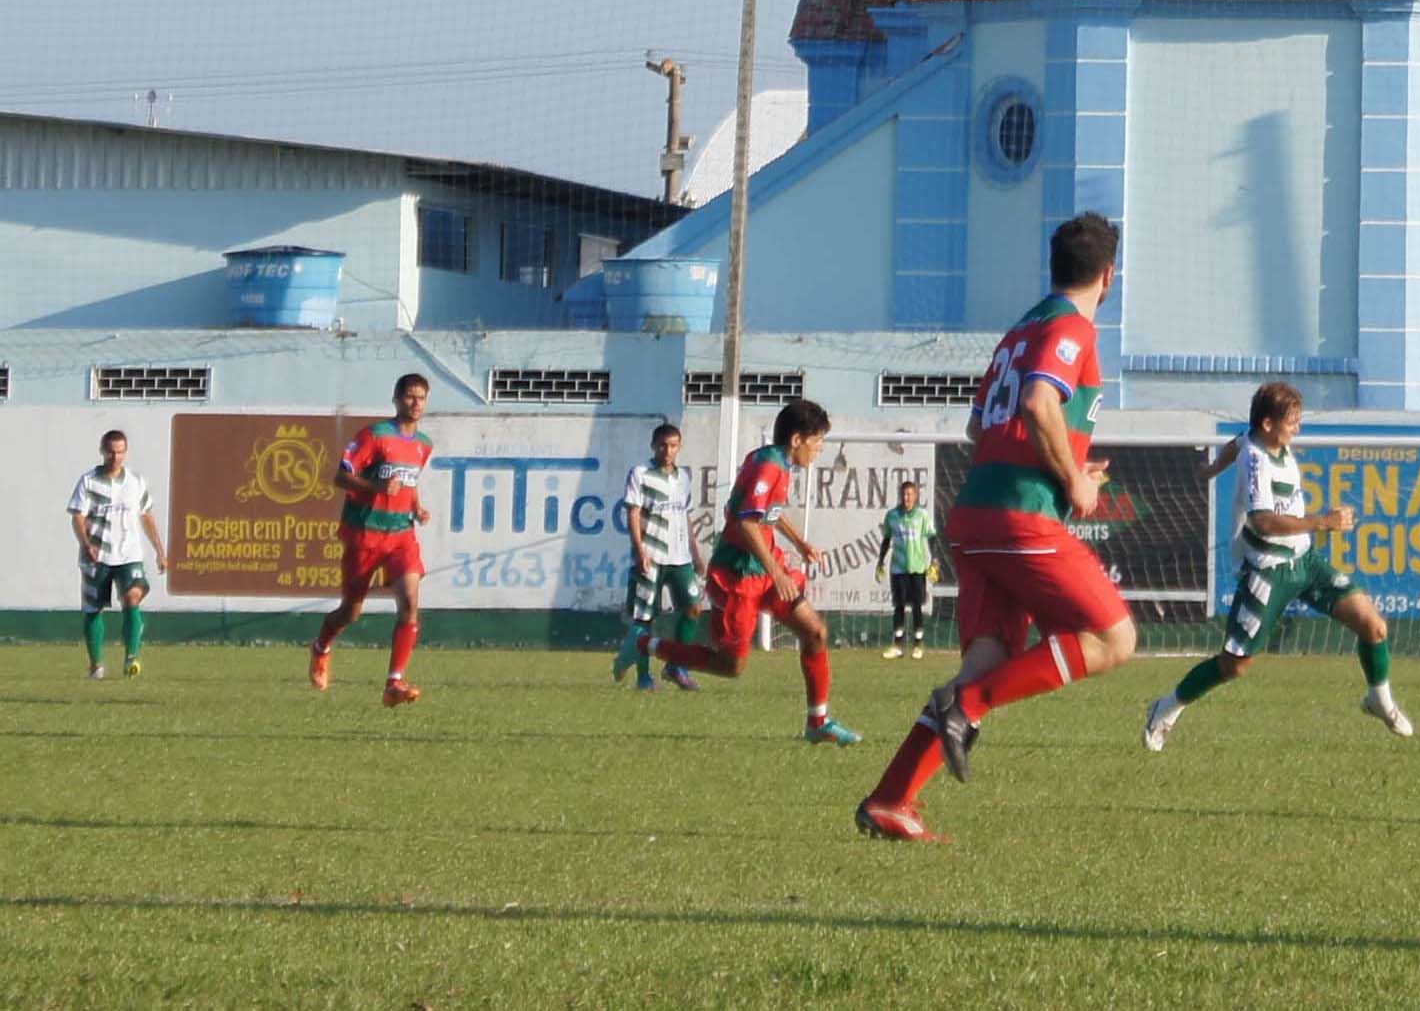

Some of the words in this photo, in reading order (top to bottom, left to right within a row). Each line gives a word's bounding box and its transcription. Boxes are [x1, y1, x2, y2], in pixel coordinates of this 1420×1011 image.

[981, 340, 1028, 430] 25
[253, 521, 281, 540] em
[284, 515, 341, 540] Porce
[1066, 523, 1110, 542] PORTS
[186, 540, 282, 560] MÁRMORES
[295, 543, 306, 560] E
[322, 543, 345, 560] GR
